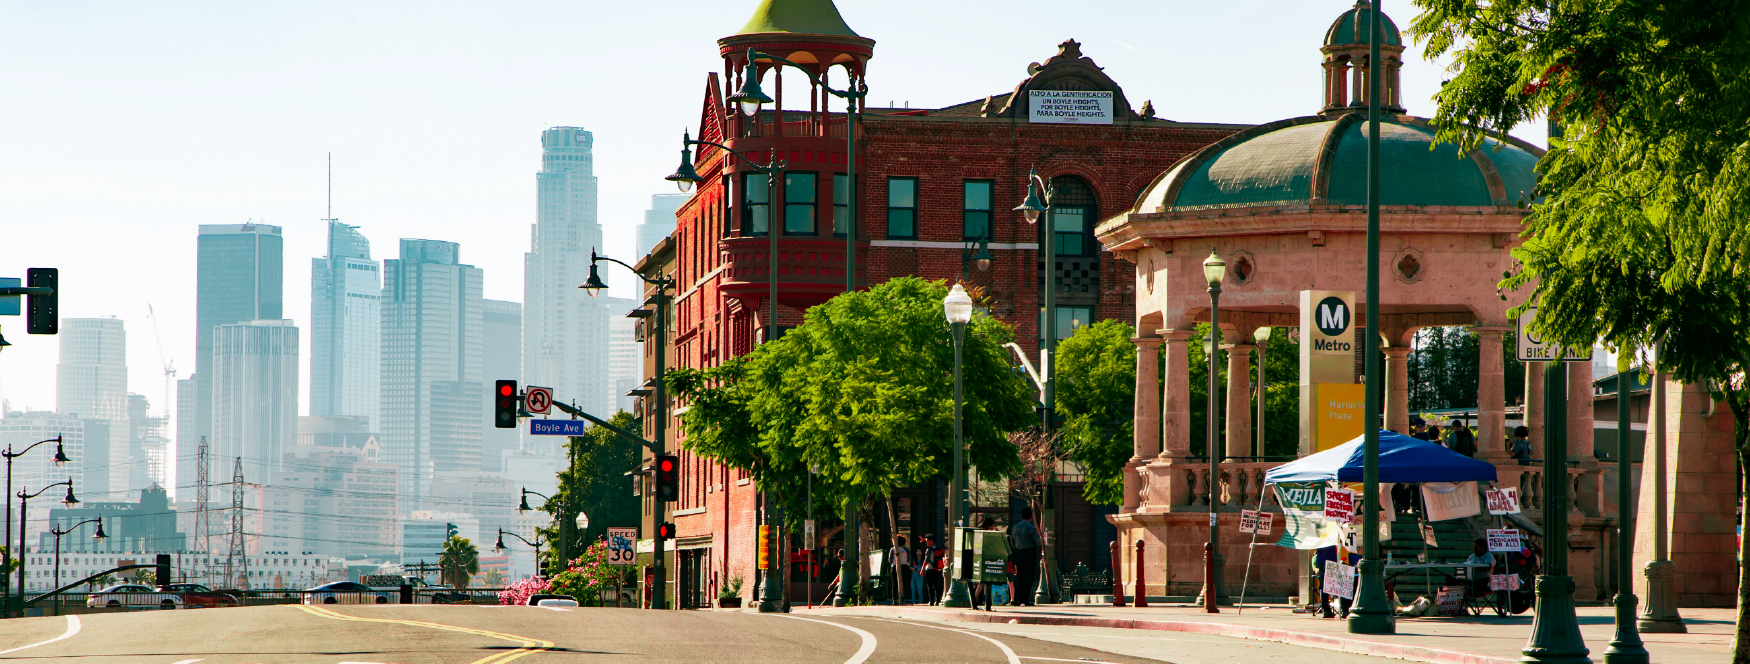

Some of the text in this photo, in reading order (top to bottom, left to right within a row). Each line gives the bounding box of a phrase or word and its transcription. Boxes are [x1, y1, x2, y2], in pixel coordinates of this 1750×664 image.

[1321, 304, 1344, 329] M
[1314, 339, 1351, 351] Metro
[1526, 347, 1550, 358] BIKE
[1329, 400, 1365, 409] Mariachi
[1329, 411, 1352, 420] Plaza
[535, 423, 579, 433] Boyle Ave
[1508, 491, 1518, 505] 4
[611, 549, 634, 561] 30
